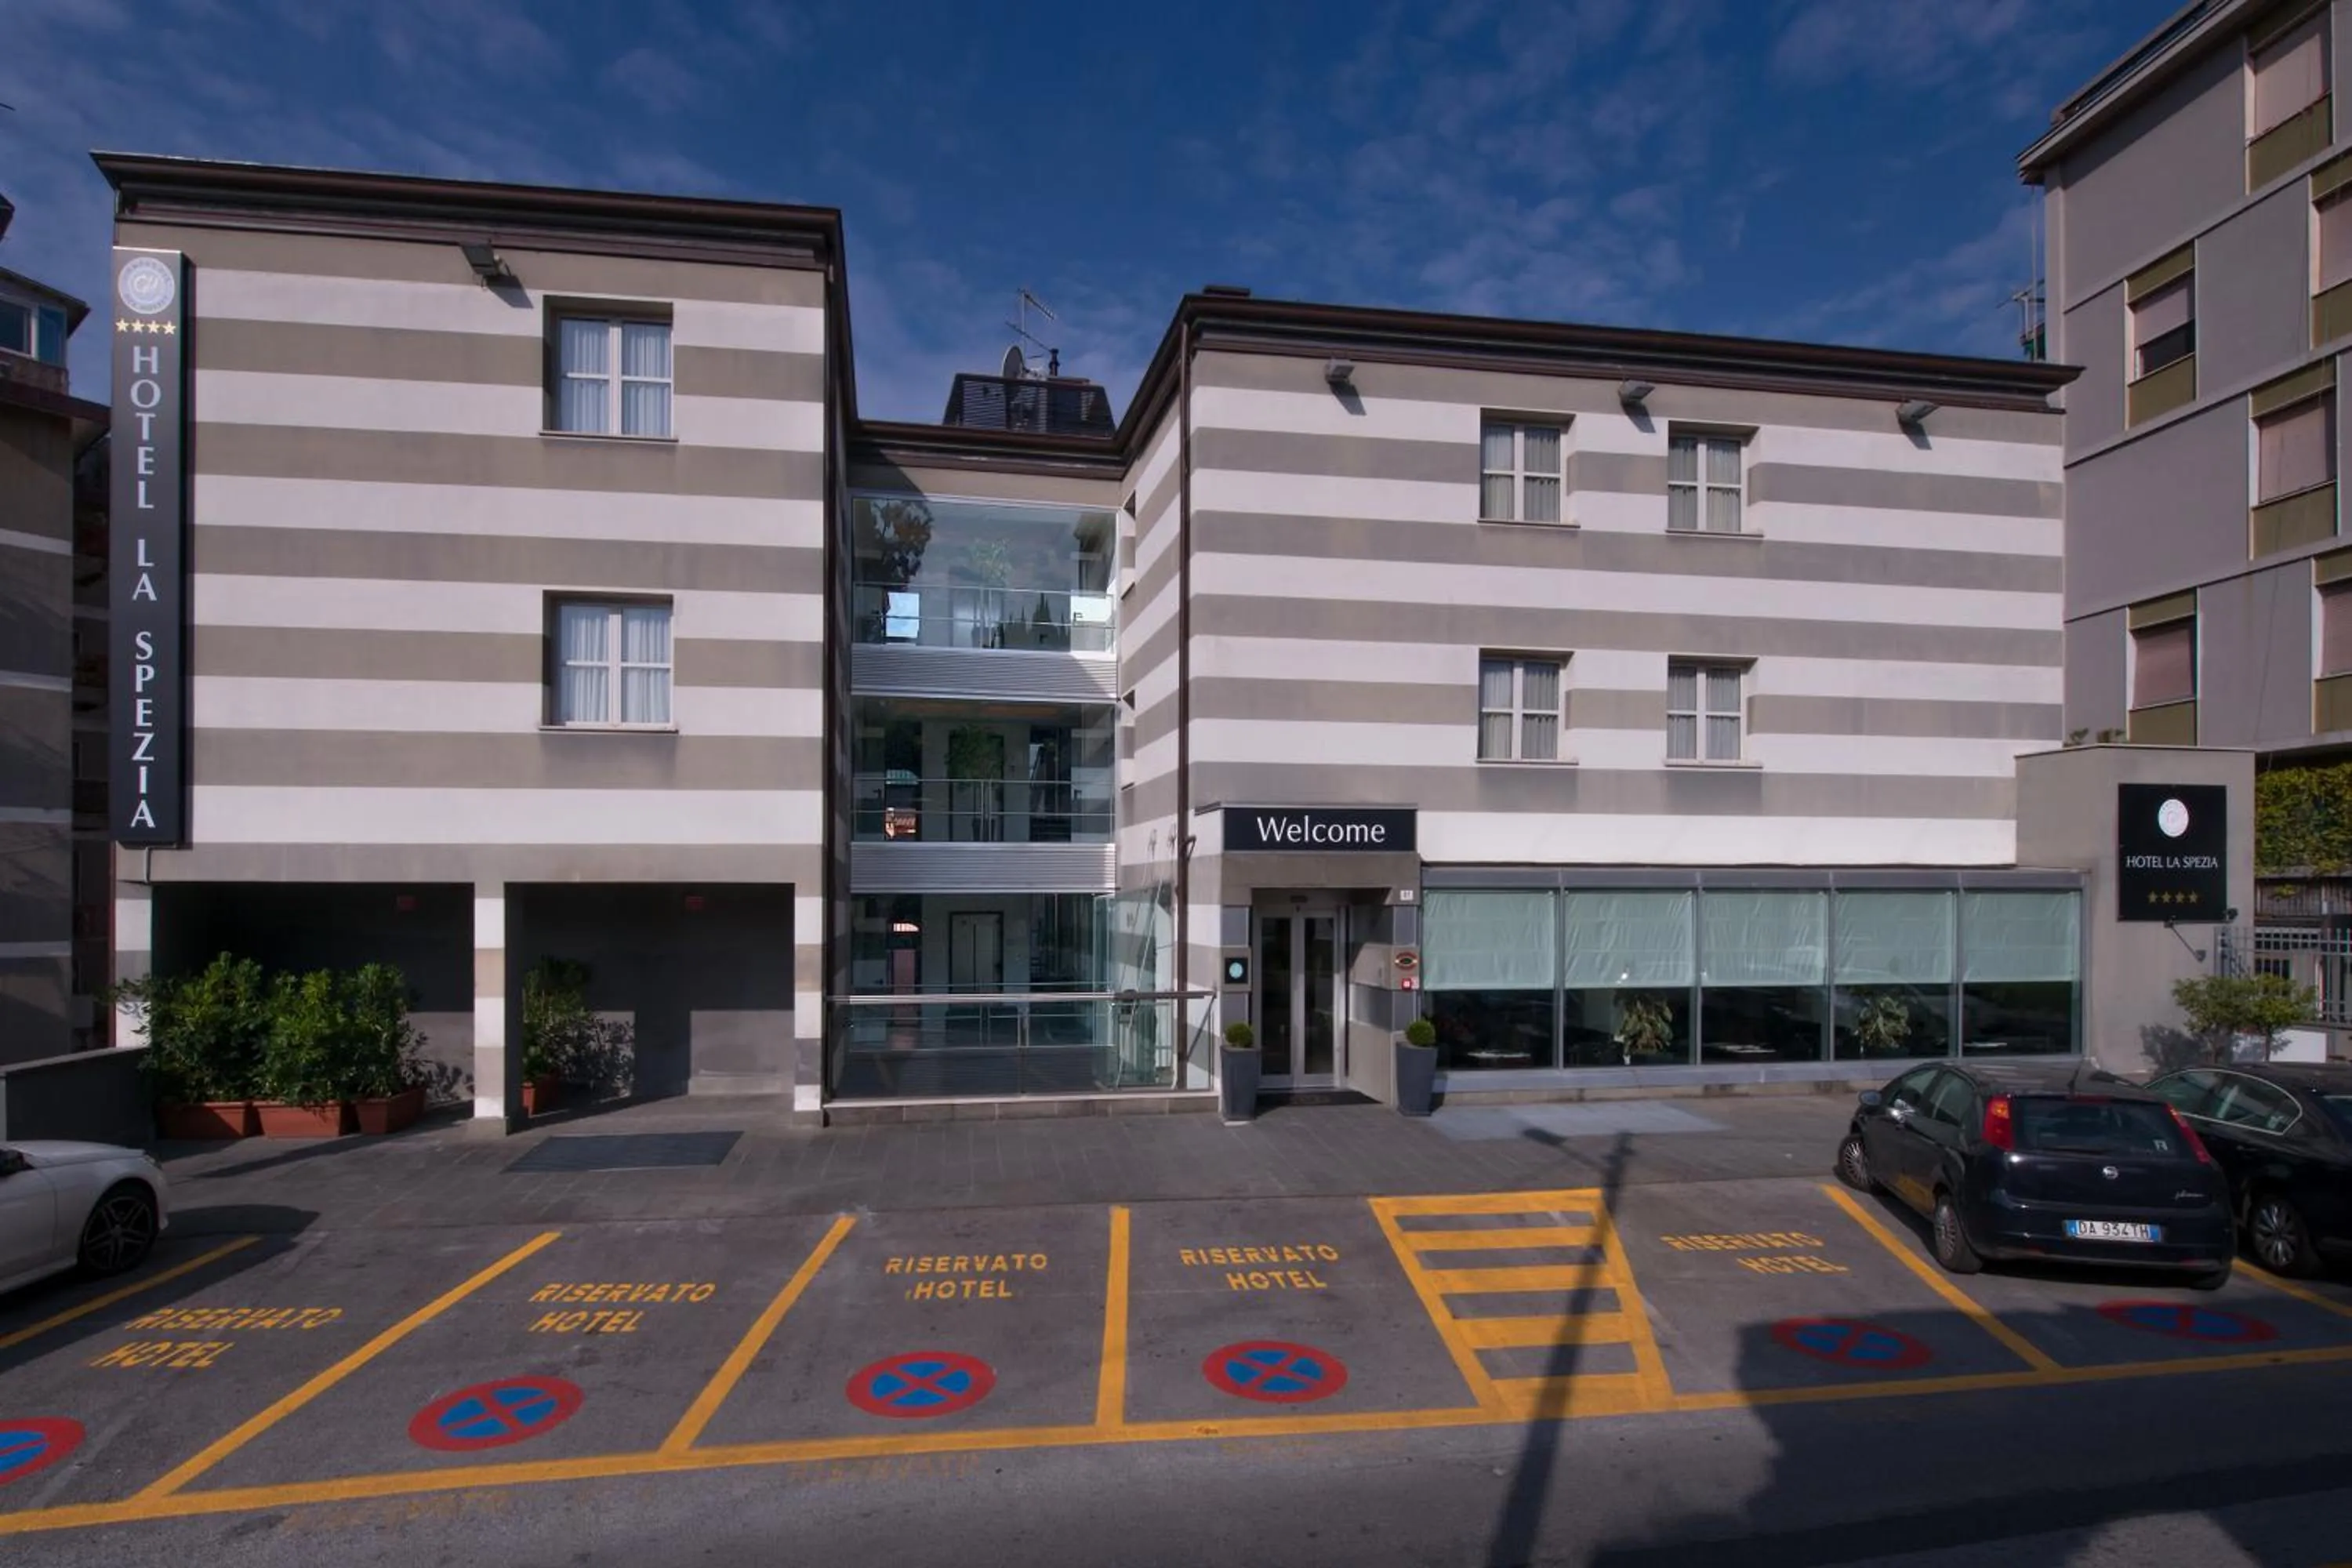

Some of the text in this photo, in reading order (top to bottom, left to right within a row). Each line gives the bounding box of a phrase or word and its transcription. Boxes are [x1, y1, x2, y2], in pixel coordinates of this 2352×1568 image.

[130, 345, 162, 828] HOTEL LA SPEZIA
[1257, 815, 1385, 843] Welcome
[2125, 855, 2218, 869] HOTEL LA SPEZIA
[1660, 1232, 1823, 1250] RISERVATO
[885, 1254, 1047, 1274] RISERVATO
[1180, 1244, 1339, 1265] RISERVATO
[1737, 1256, 1848, 1274] HOTEL
[914, 1279, 1012, 1299] HOTEL
[1227, 1270, 1327, 1290] HOTEL
[528, 1283, 716, 1302] RISERVATO
[125, 1308, 343, 1330] RISERVATO
[529, 1311, 644, 1333] HOTEL
[90, 1341, 235, 1367] HOTEL
